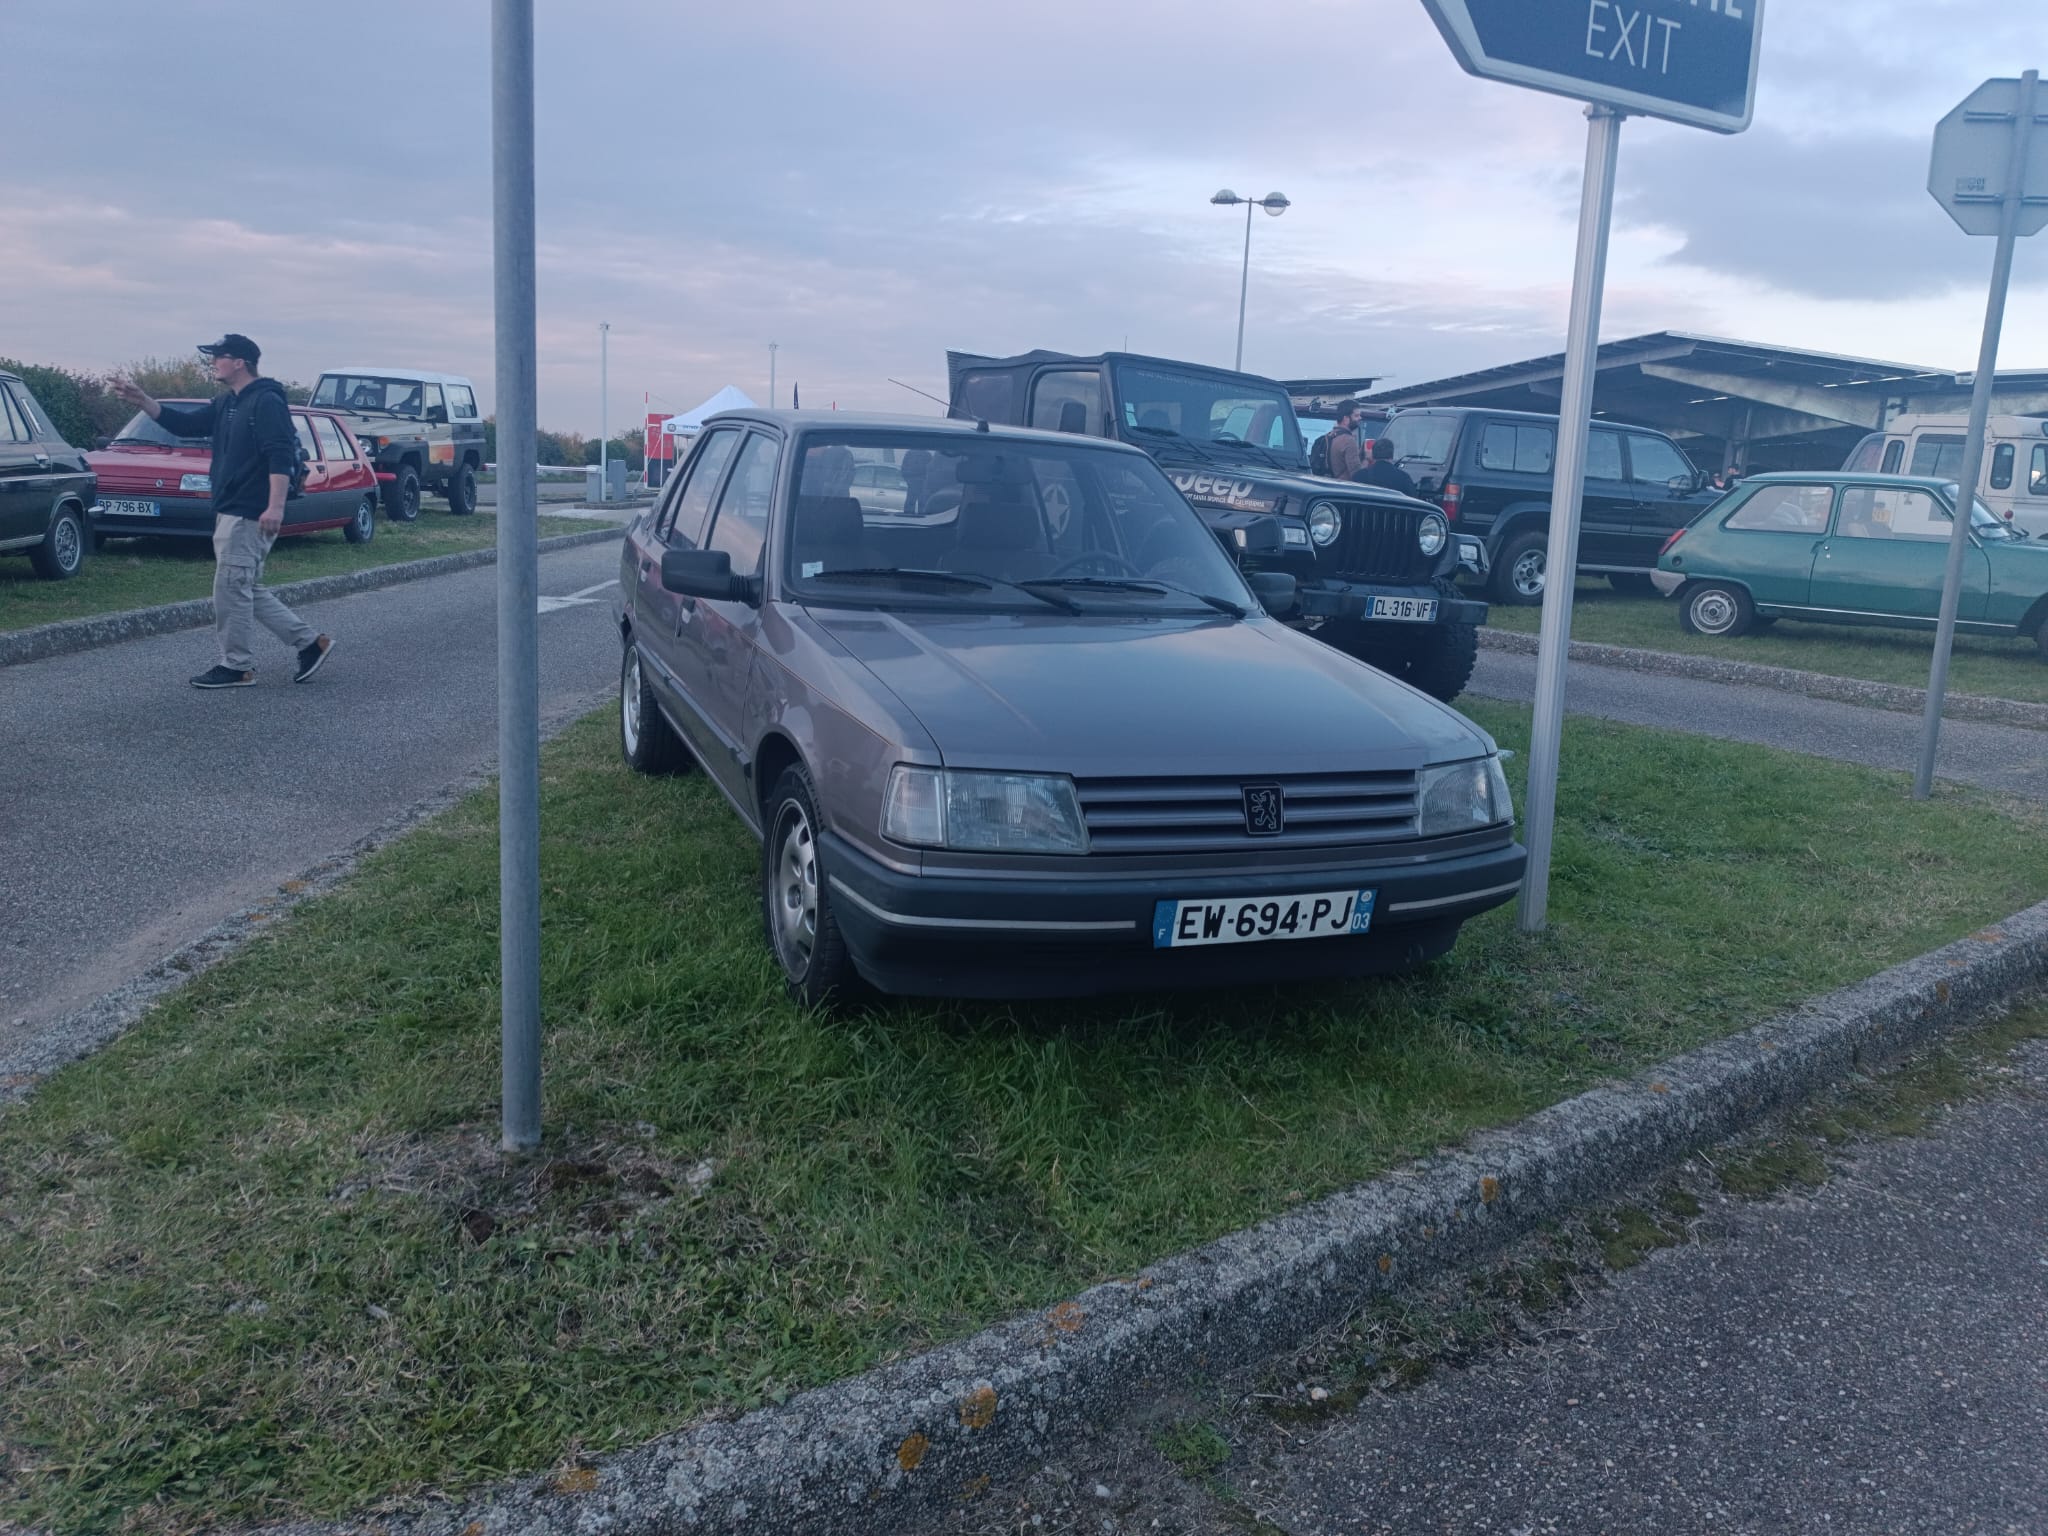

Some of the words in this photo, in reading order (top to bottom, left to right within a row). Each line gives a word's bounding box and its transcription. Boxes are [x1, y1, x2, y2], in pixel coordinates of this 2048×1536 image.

[1585, 0, 1682, 75] EXIT
[1374, 599, 1430, 618] CL-316-VF
[1177, 896, 1354, 940] EW-694-PJ
[1352, 912, 1370, 929] 03
[1157, 928, 1167, 940] F
